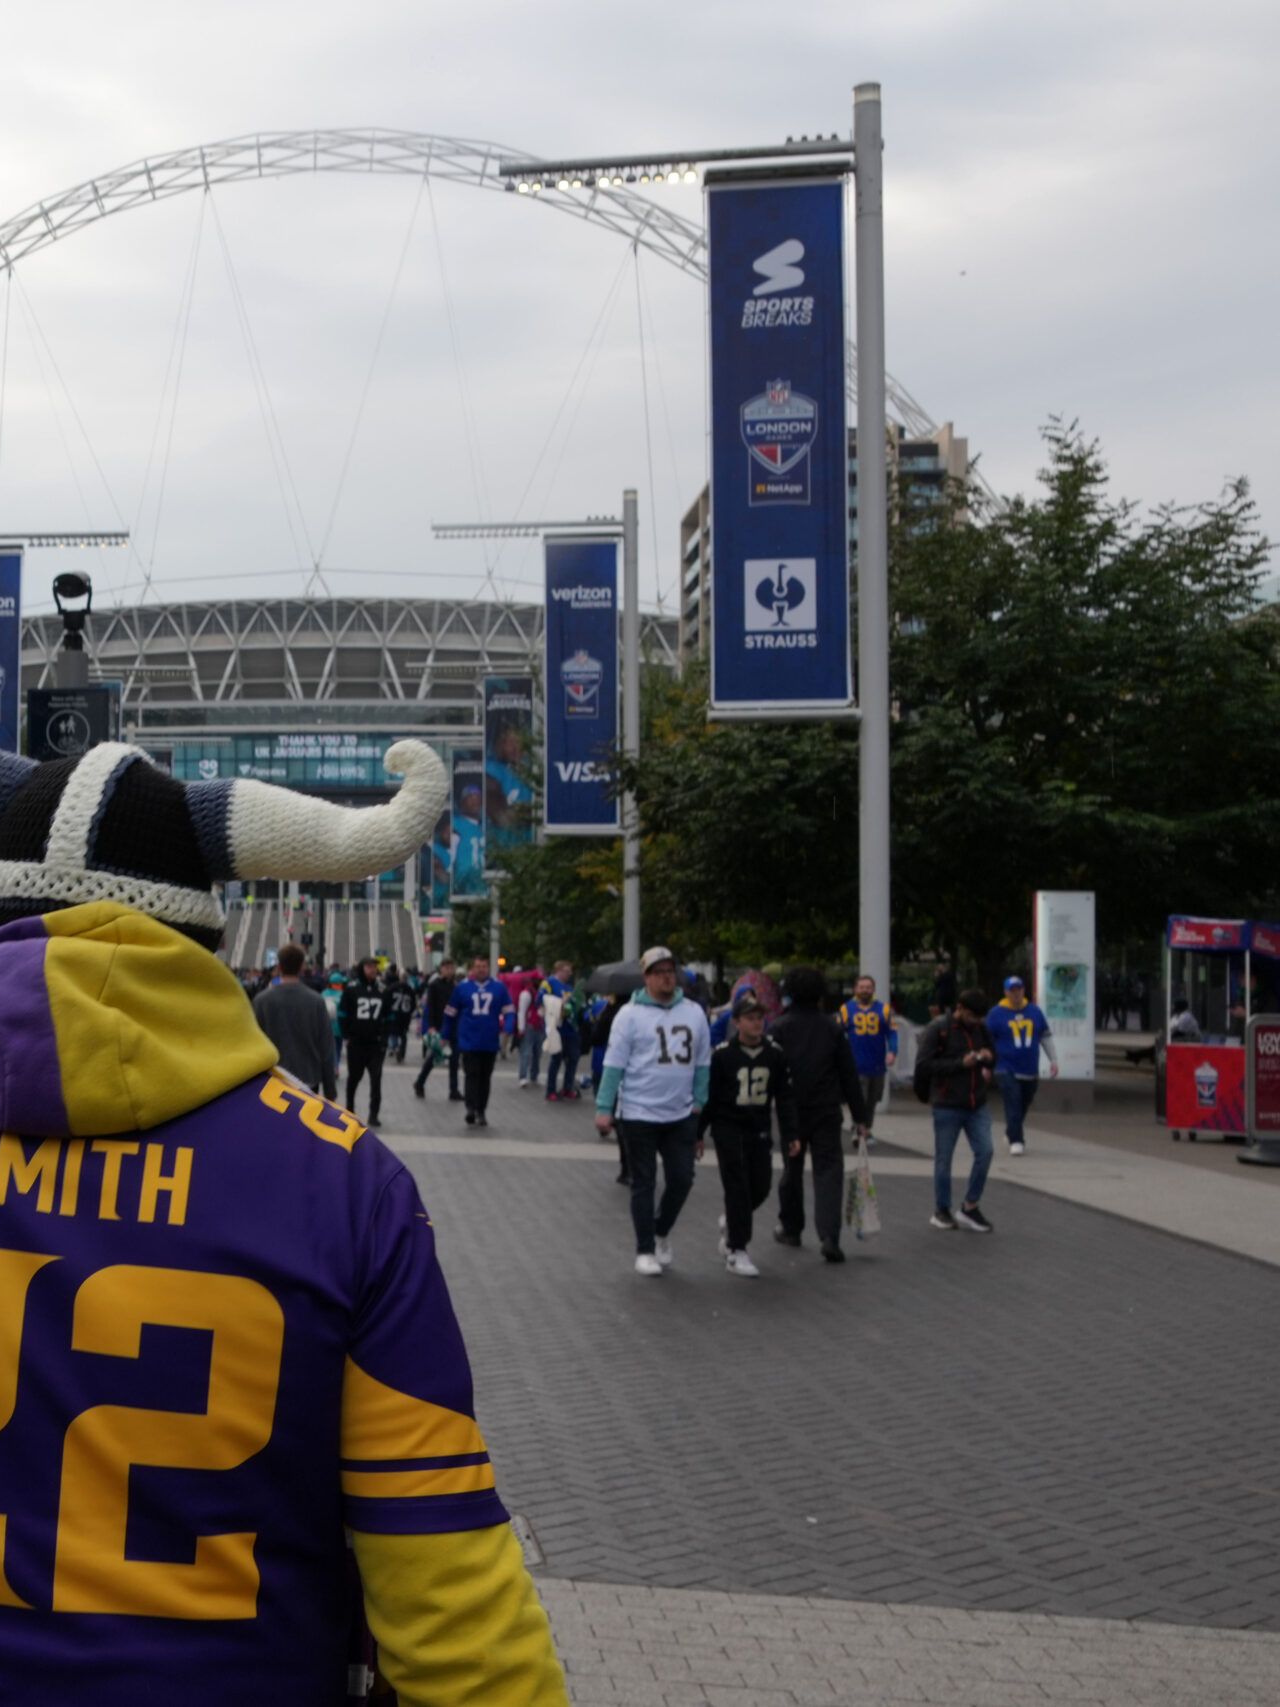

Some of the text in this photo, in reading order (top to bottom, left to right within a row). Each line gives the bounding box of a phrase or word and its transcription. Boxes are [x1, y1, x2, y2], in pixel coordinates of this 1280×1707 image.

[743, 296, 814, 313] SPORTS
[741, 311, 812, 329] BREAKS
[746, 421, 812, 436] LONDON
[767, 484, 803, 494] NetApp
[552, 585, 612, 601] verizon
[744, 634, 817, 649] STRAUSS
[278, 735, 358, 745] THANK YOU TO
[272, 746, 322, 758] JAGUARS
[324, 746, 381, 758] PARTNERS
[554, 760, 611, 782] VISA
[356, 997, 382, 1020] 27
[471, 992, 493, 1016] 17
[853, 1012, 880, 1036] 99
[1007, 1018, 1034, 1049] 17
[656, 1025, 693, 1065] 13
[735, 1066, 771, 1106] 12
